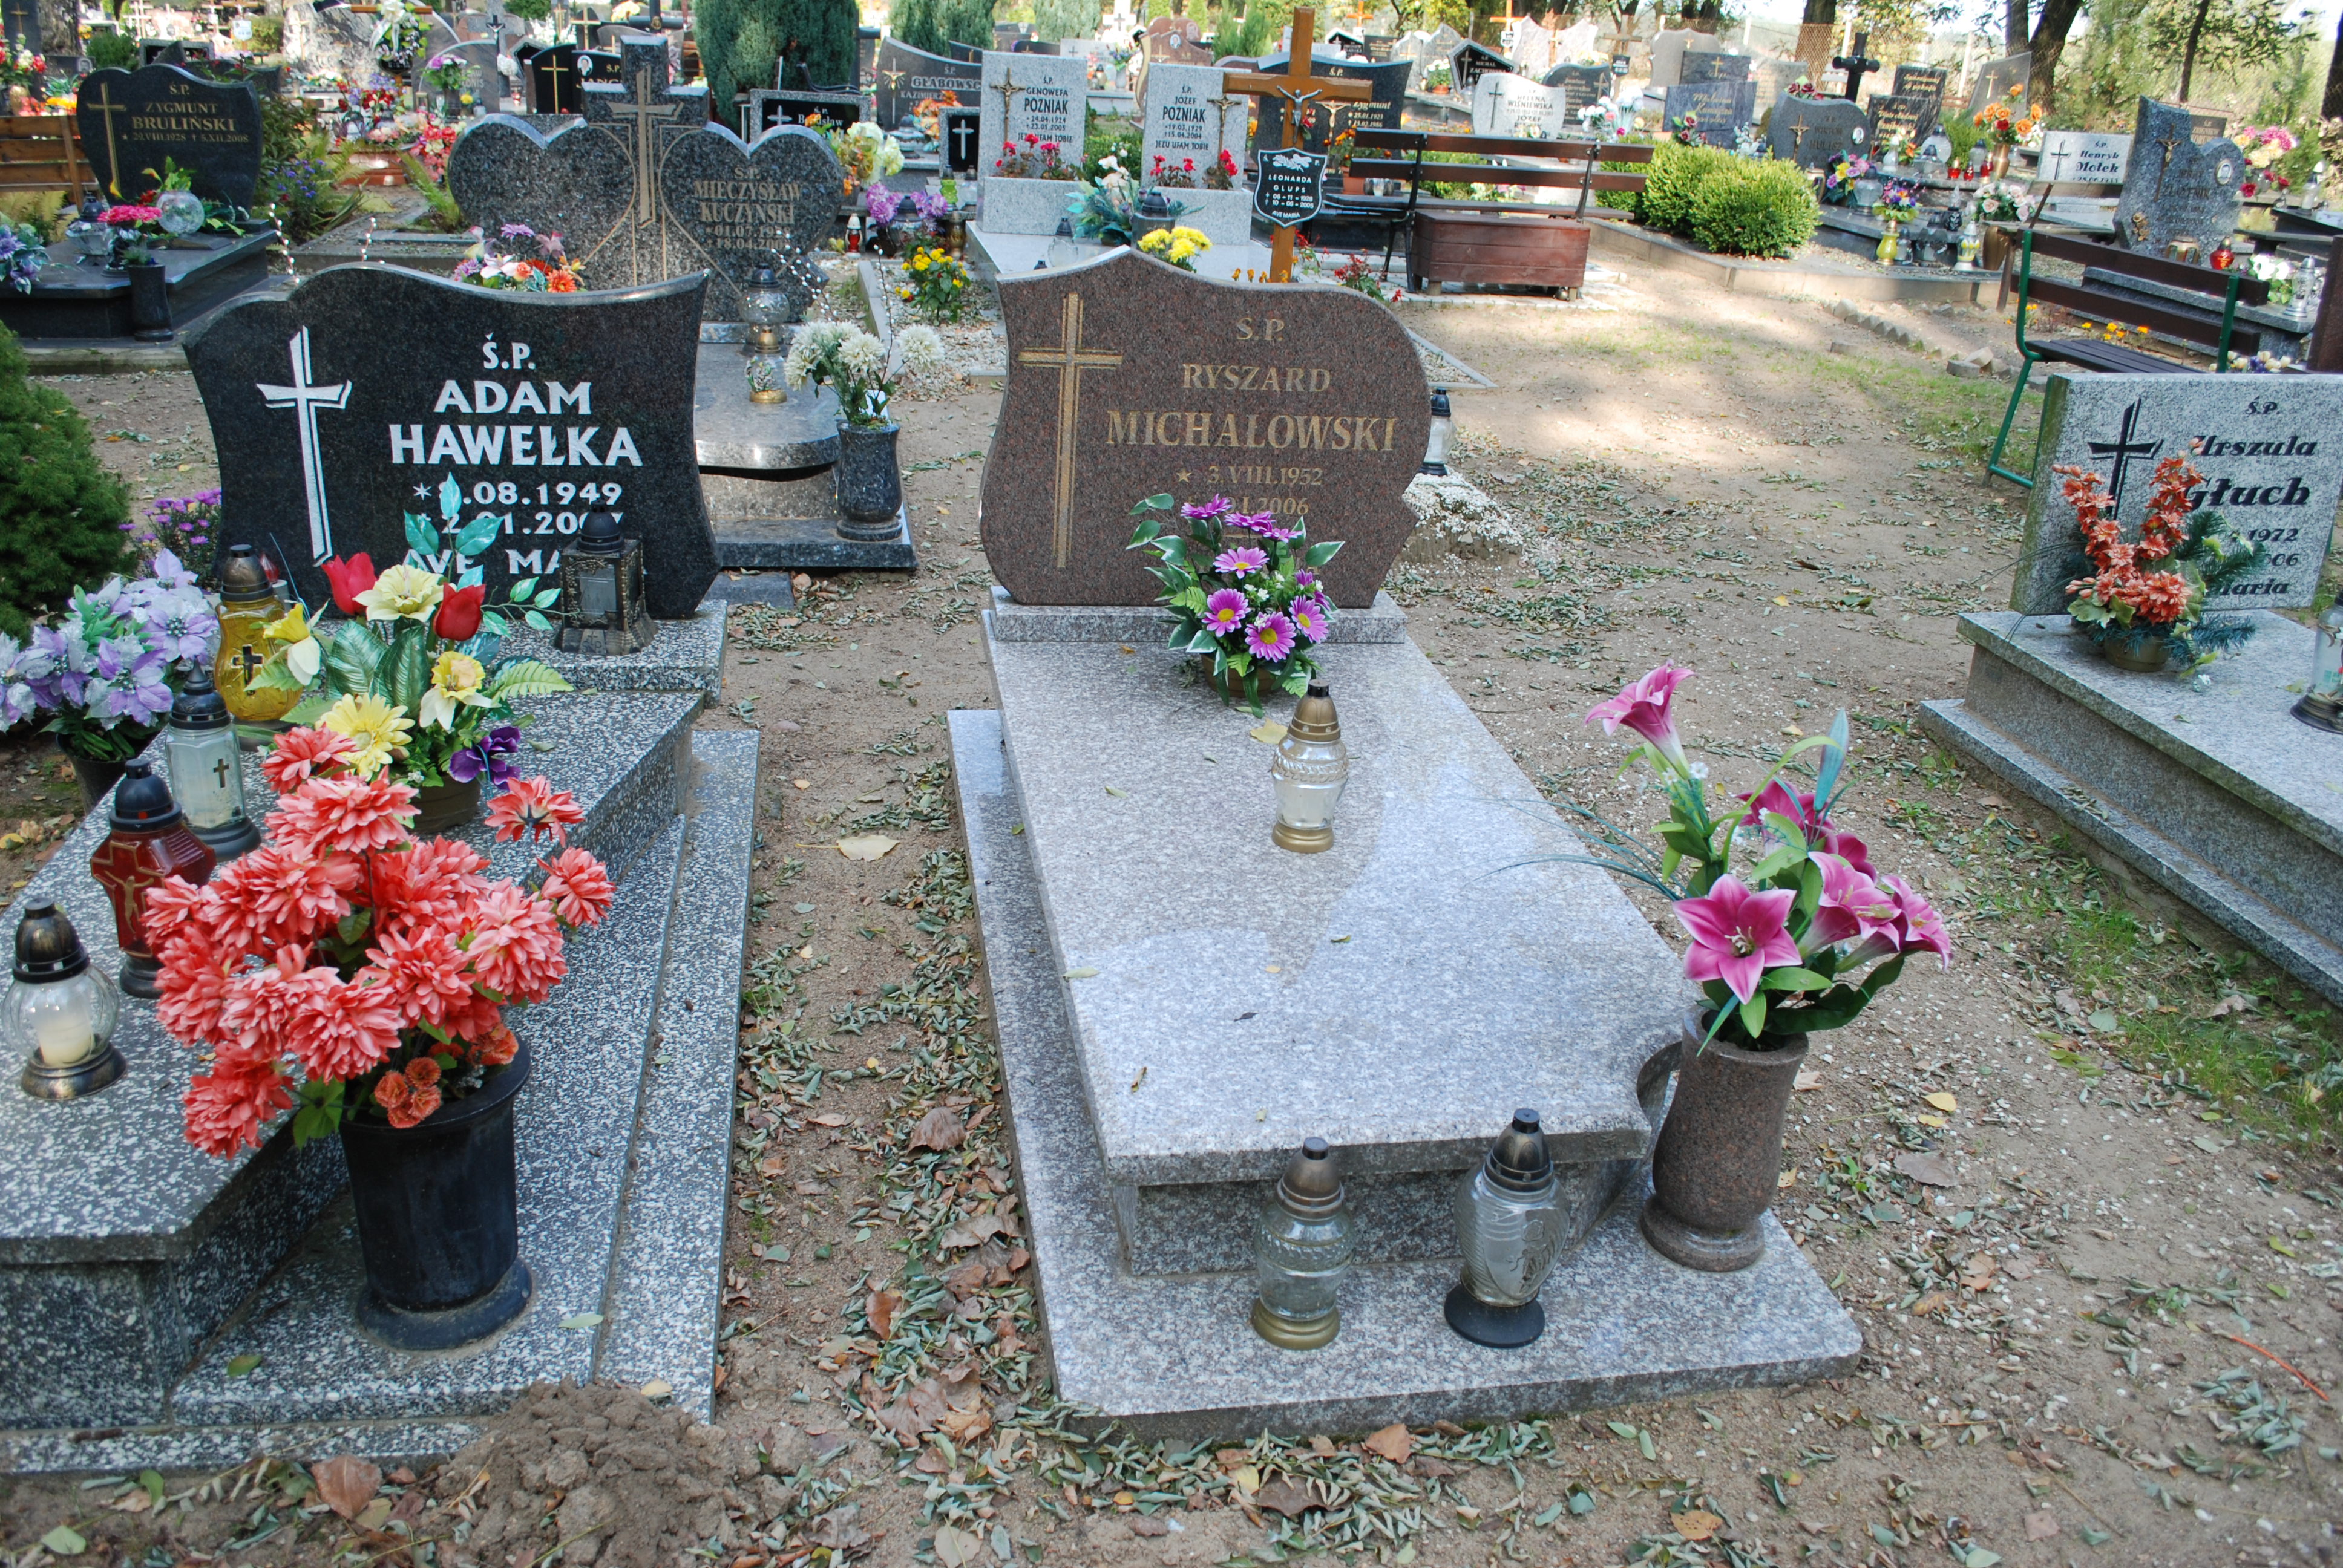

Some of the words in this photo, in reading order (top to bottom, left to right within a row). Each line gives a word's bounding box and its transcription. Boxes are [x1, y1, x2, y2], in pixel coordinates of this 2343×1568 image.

[169, 80, 191, 95] Ś.P.
[1026, 87, 1069, 97] GENOWEFA
[145, 102, 218, 114] ZYGMUNT
[131, 116, 237, 131] BRULIŃSKI
[1055, 134, 1073, 143] TOBIE
[1155, 140, 1170, 149] JEZU
[1172, 141, 1189, 149] UFAM
[1191, 142, 1209, 151] TOBIE
[2080, 149, 2120, 159] Henryk
[1268, 174, 1312, 184] LEONARDA
[694, 180, 803, 201] MIECZYSŁAW
[1273, 184, 1306, 194] GLUPS
[716, 238, 790, 250] 18.04.200
[482, 332, 536, 370] Ś.P.
[1182, 364, 1332, 393] RYSZARD
[433, 379, 592, 416] ADAM
[2244, 396, 2281, 415] Ś.P.
[388, 423, 644, 467] HAWEŁKA
[439, 481, 623, 505] .08.1949
